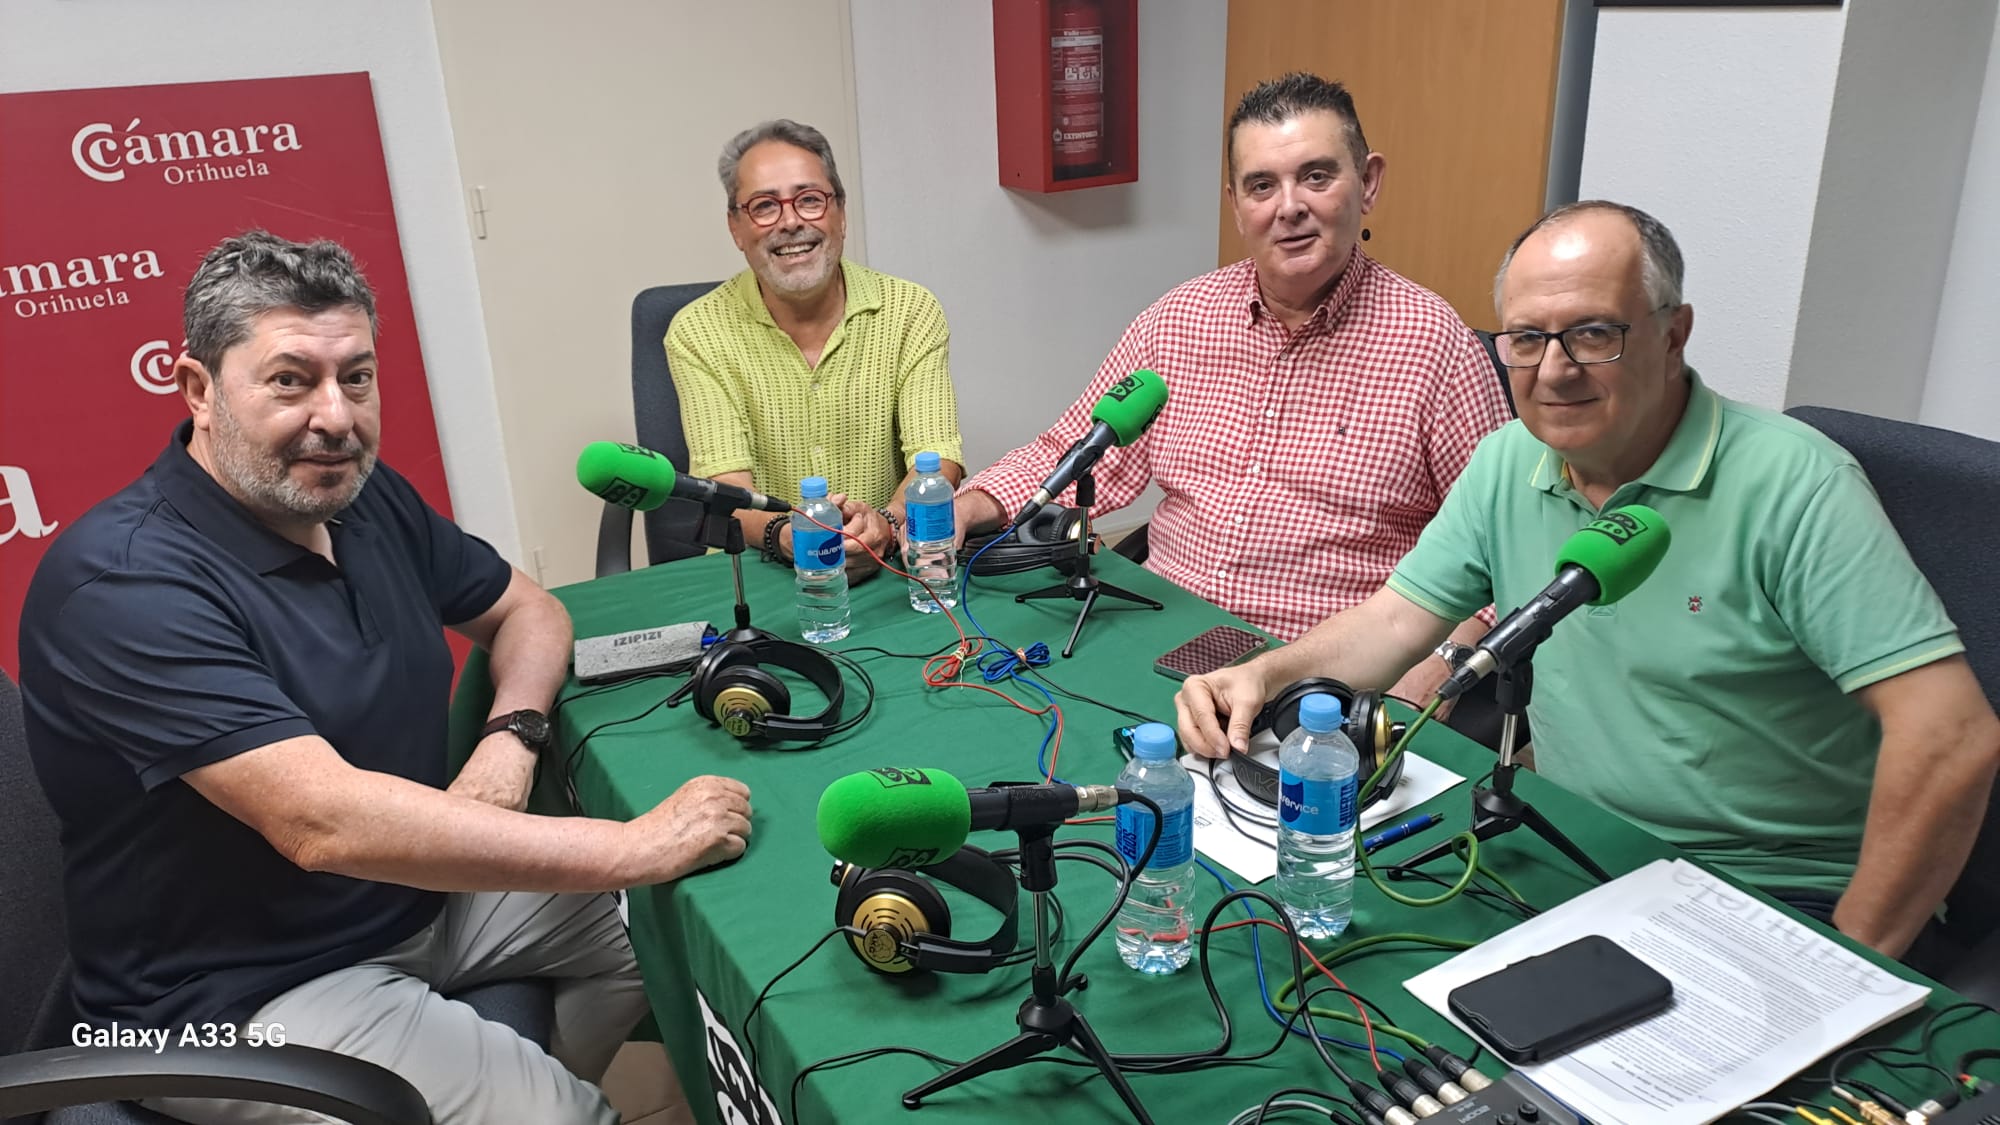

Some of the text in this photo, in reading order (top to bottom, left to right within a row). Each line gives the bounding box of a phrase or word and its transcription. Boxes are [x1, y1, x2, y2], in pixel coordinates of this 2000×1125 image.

[163, 158, 270, 185] Orihuela
[14, 287, 131, 318] Orihuela
[613, 630, 663, 647] IZIPIZI
